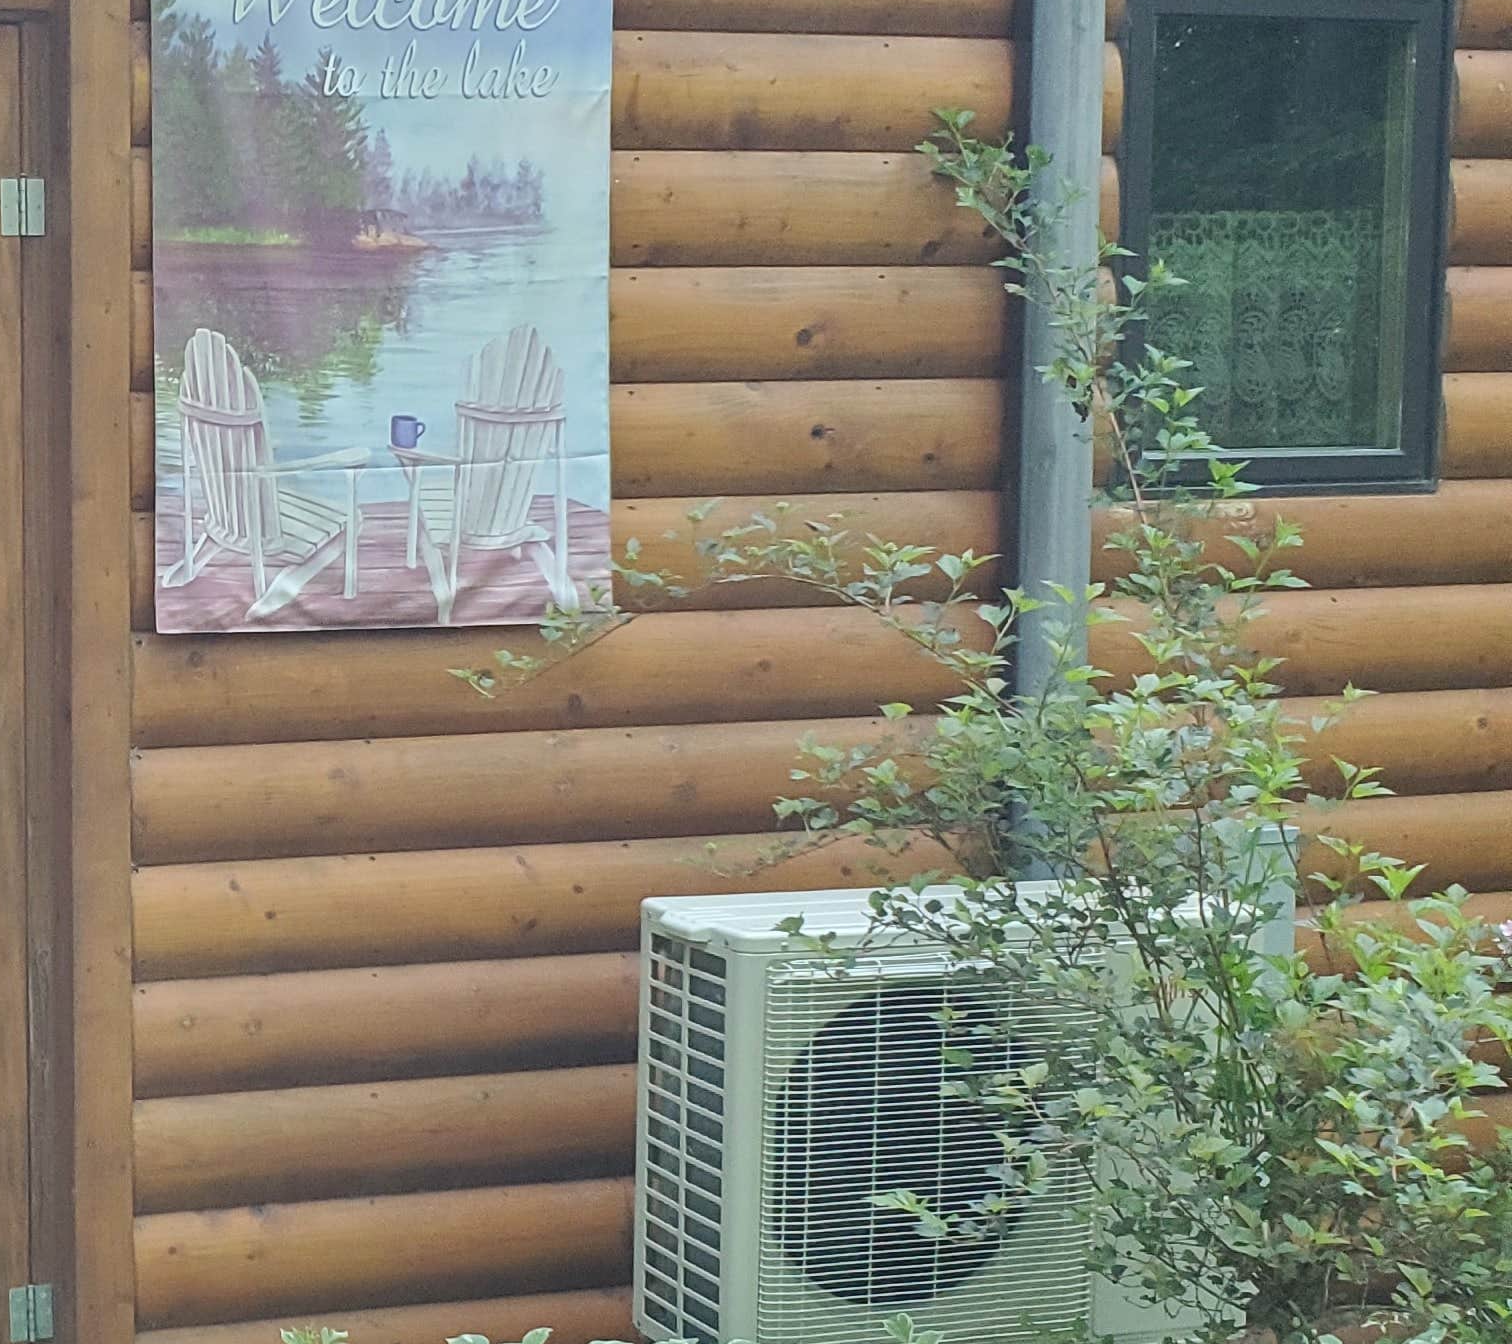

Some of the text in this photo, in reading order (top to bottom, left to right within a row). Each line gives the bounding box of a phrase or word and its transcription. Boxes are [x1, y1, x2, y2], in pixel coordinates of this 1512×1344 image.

[323, 38, 559, 99] to the lake
